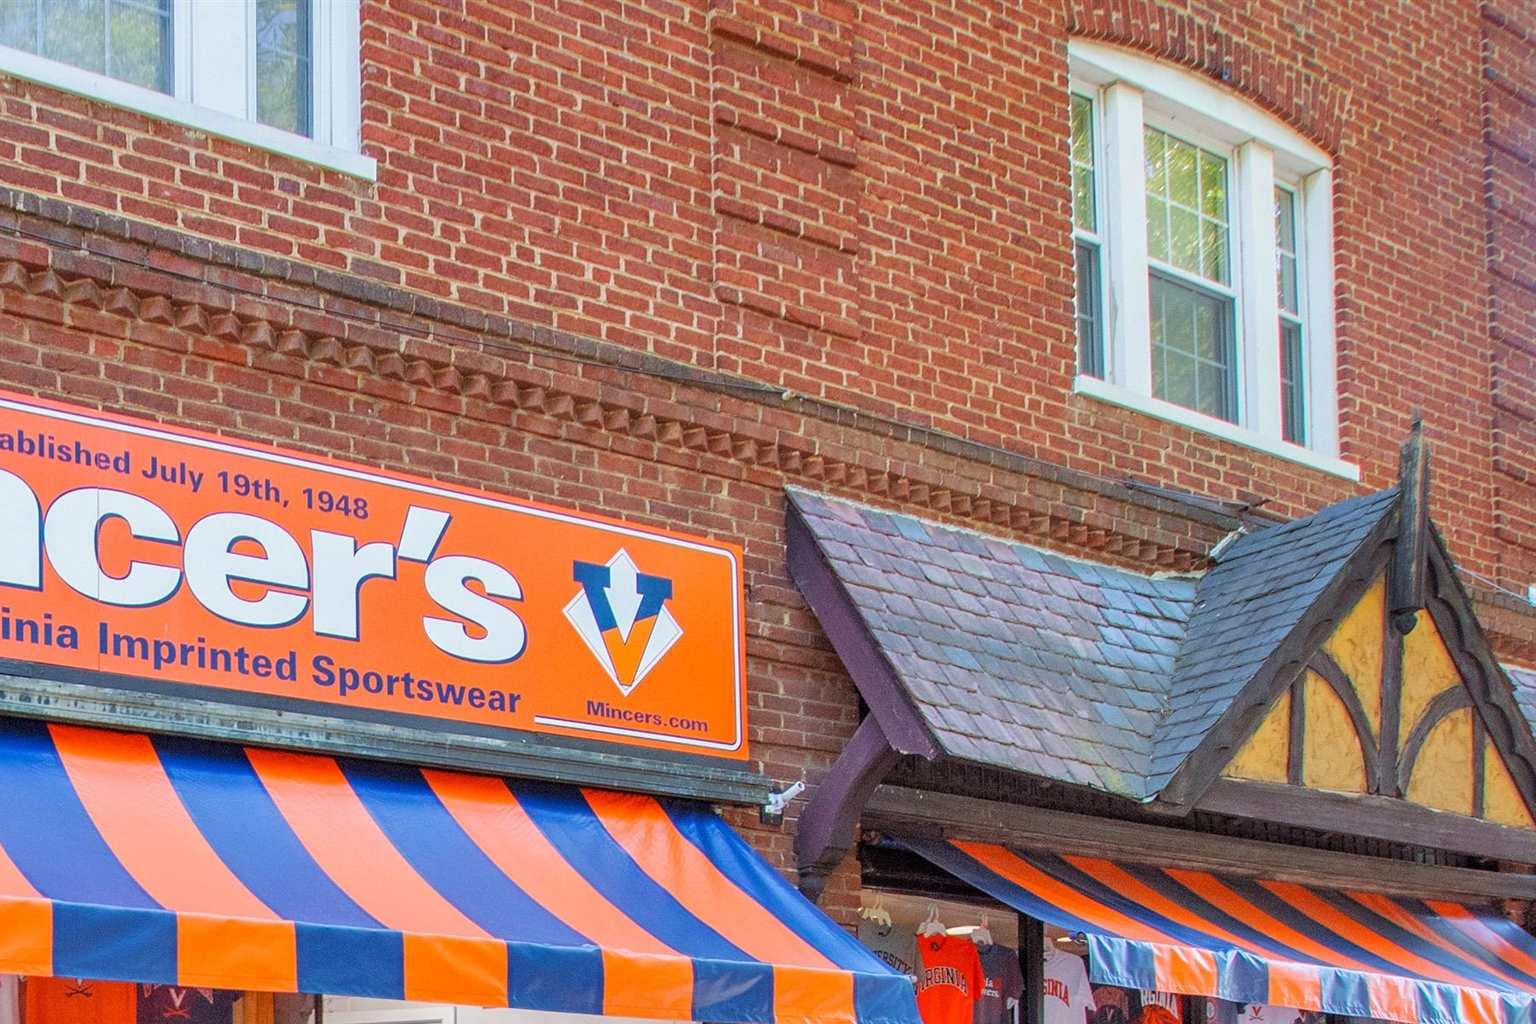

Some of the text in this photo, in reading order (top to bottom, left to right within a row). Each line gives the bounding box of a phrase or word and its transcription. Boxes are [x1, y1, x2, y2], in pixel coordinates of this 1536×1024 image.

[140, 455, 204, 494] July
[217, 471, 290, 507] 19th,
[302, 487, 369, 520] 1948
[98, 620, 298, 684] Imprinted
[311, 655, 522, 714] Sportswear
[585, 700, 709, 733] Mincers.com
[873, 949, 913, 975] ERSITY
